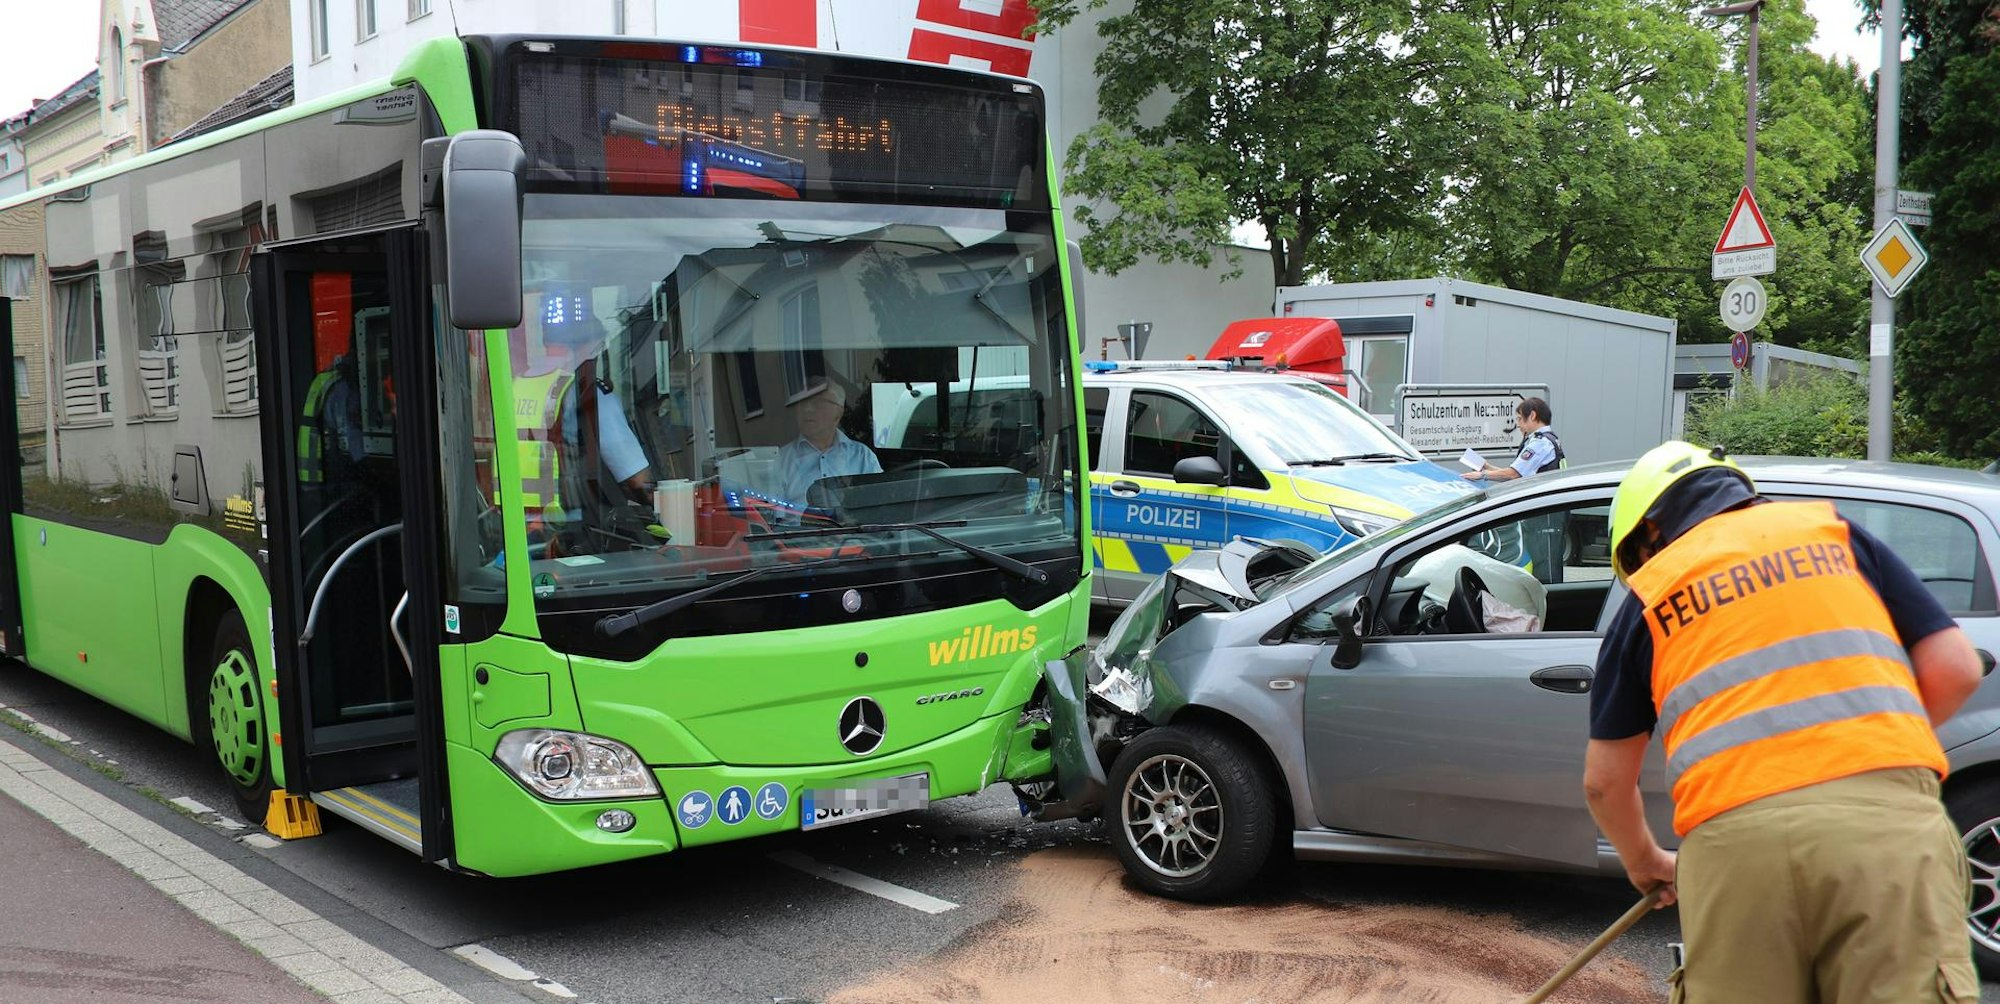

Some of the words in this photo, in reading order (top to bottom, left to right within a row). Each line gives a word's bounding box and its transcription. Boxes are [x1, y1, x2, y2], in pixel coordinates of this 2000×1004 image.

[658, 104, 891, 152] Dienstfahrt
[1730, 291, 1756, 316] 30
[516, 399, 538, 416] IZEI
[1410, 402, 1471, 419] Schulzentrum
[1410, 424, 1454, 435] Gesamtschule
[1455, 424, 1482, 435] Siegburg
[1410, 437, 1441, 447] Alexander
[226, 495, 253, 514] willms
[1126, 503, 1201, 530] POLIZEI
[540, 574, 549, 587] 4
[1652, 543, 1850, 638] FEUERWEHR
[929, 624, 1038, 667] willms
[916, 686, 984, 705] CITARO
